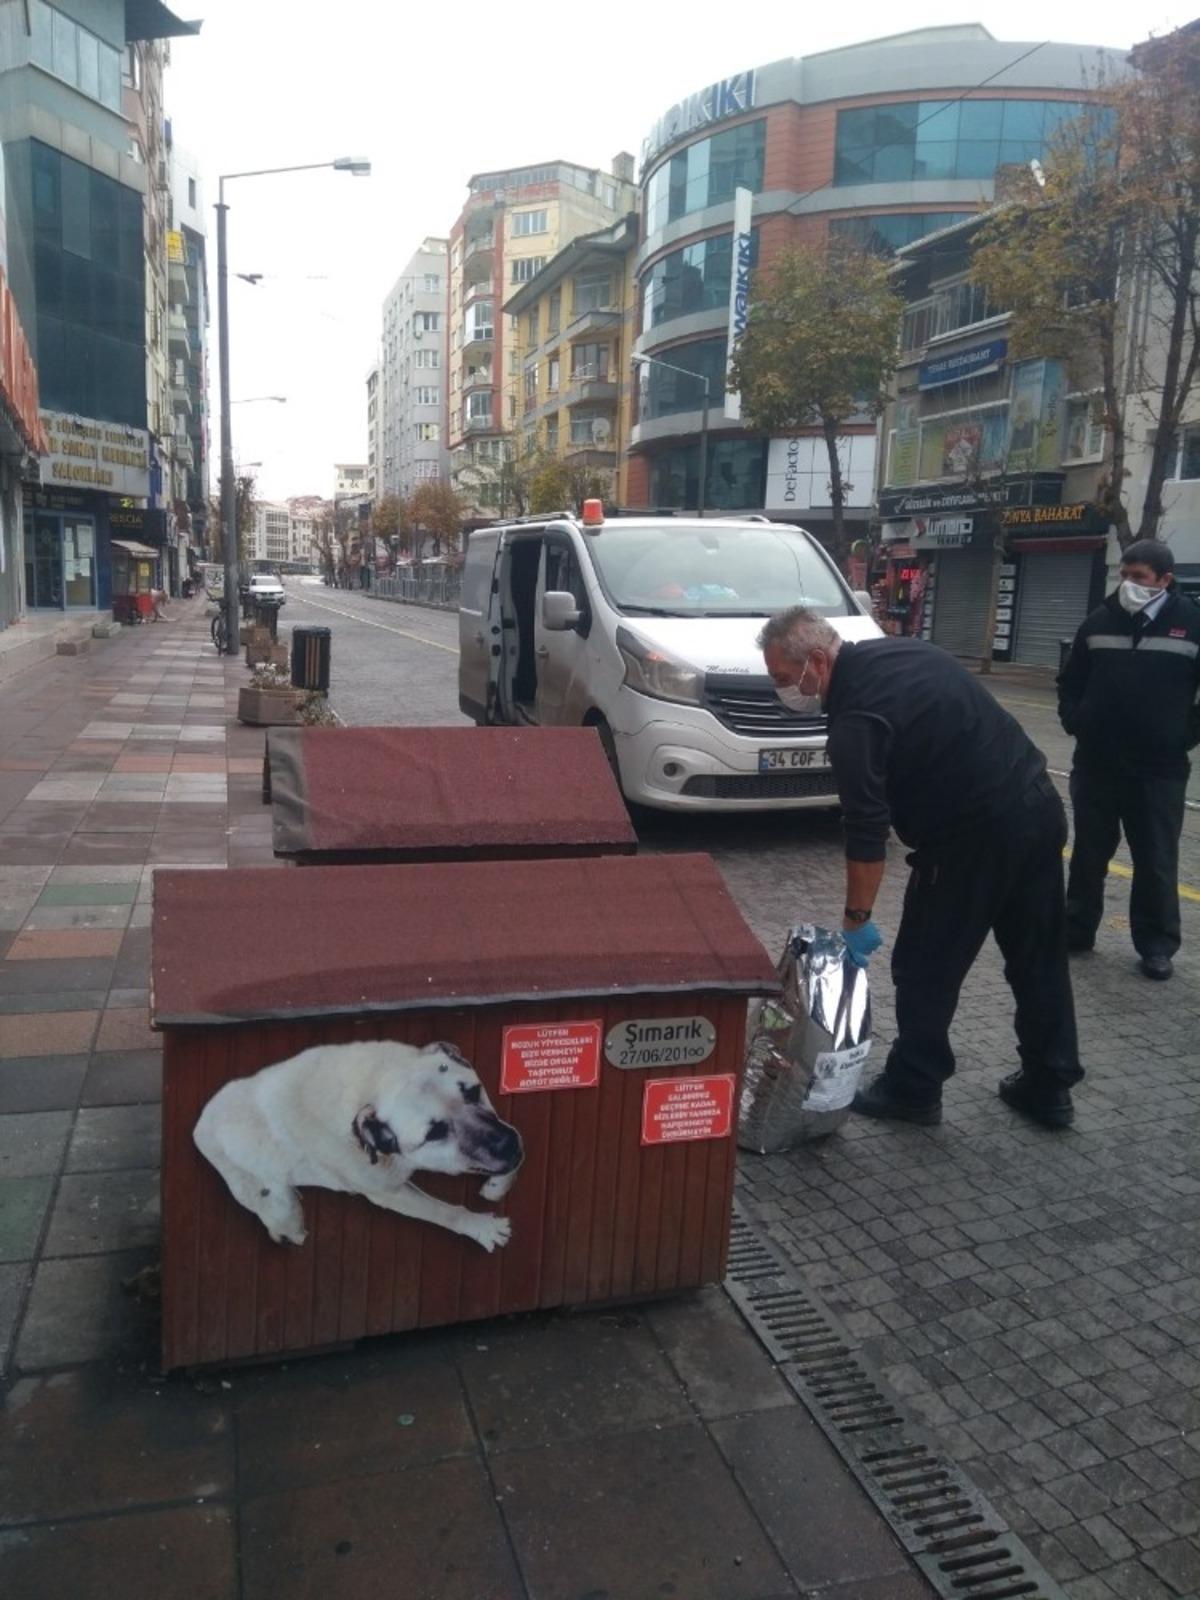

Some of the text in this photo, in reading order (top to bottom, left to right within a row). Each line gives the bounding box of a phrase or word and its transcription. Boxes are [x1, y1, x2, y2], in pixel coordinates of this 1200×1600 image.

[784, 440, 800, 502] DeFacto
[1034, 504, 1086, 523] BAHARAT
[769, 752, 786, 768] 34
[791, 751, 817, 767] COF
[537, 1028, 569, 1038] LÜTFEN
[624, 1019, 703, 1050] Şımarık
[511, 1040, 540, 1050] BOZUK
[540, 1046, 584, 1057] VERMEYİN
[550, 1056, 579, 1066] ORGAN
[527, 1066, 574, 1078] TAŞIYORUZ
[519, 1078, 548, 1089] ROBOT
[674, 1083, 705, 1093] LÜTFEN
[690, 1099, 717, 1109] KADAR
